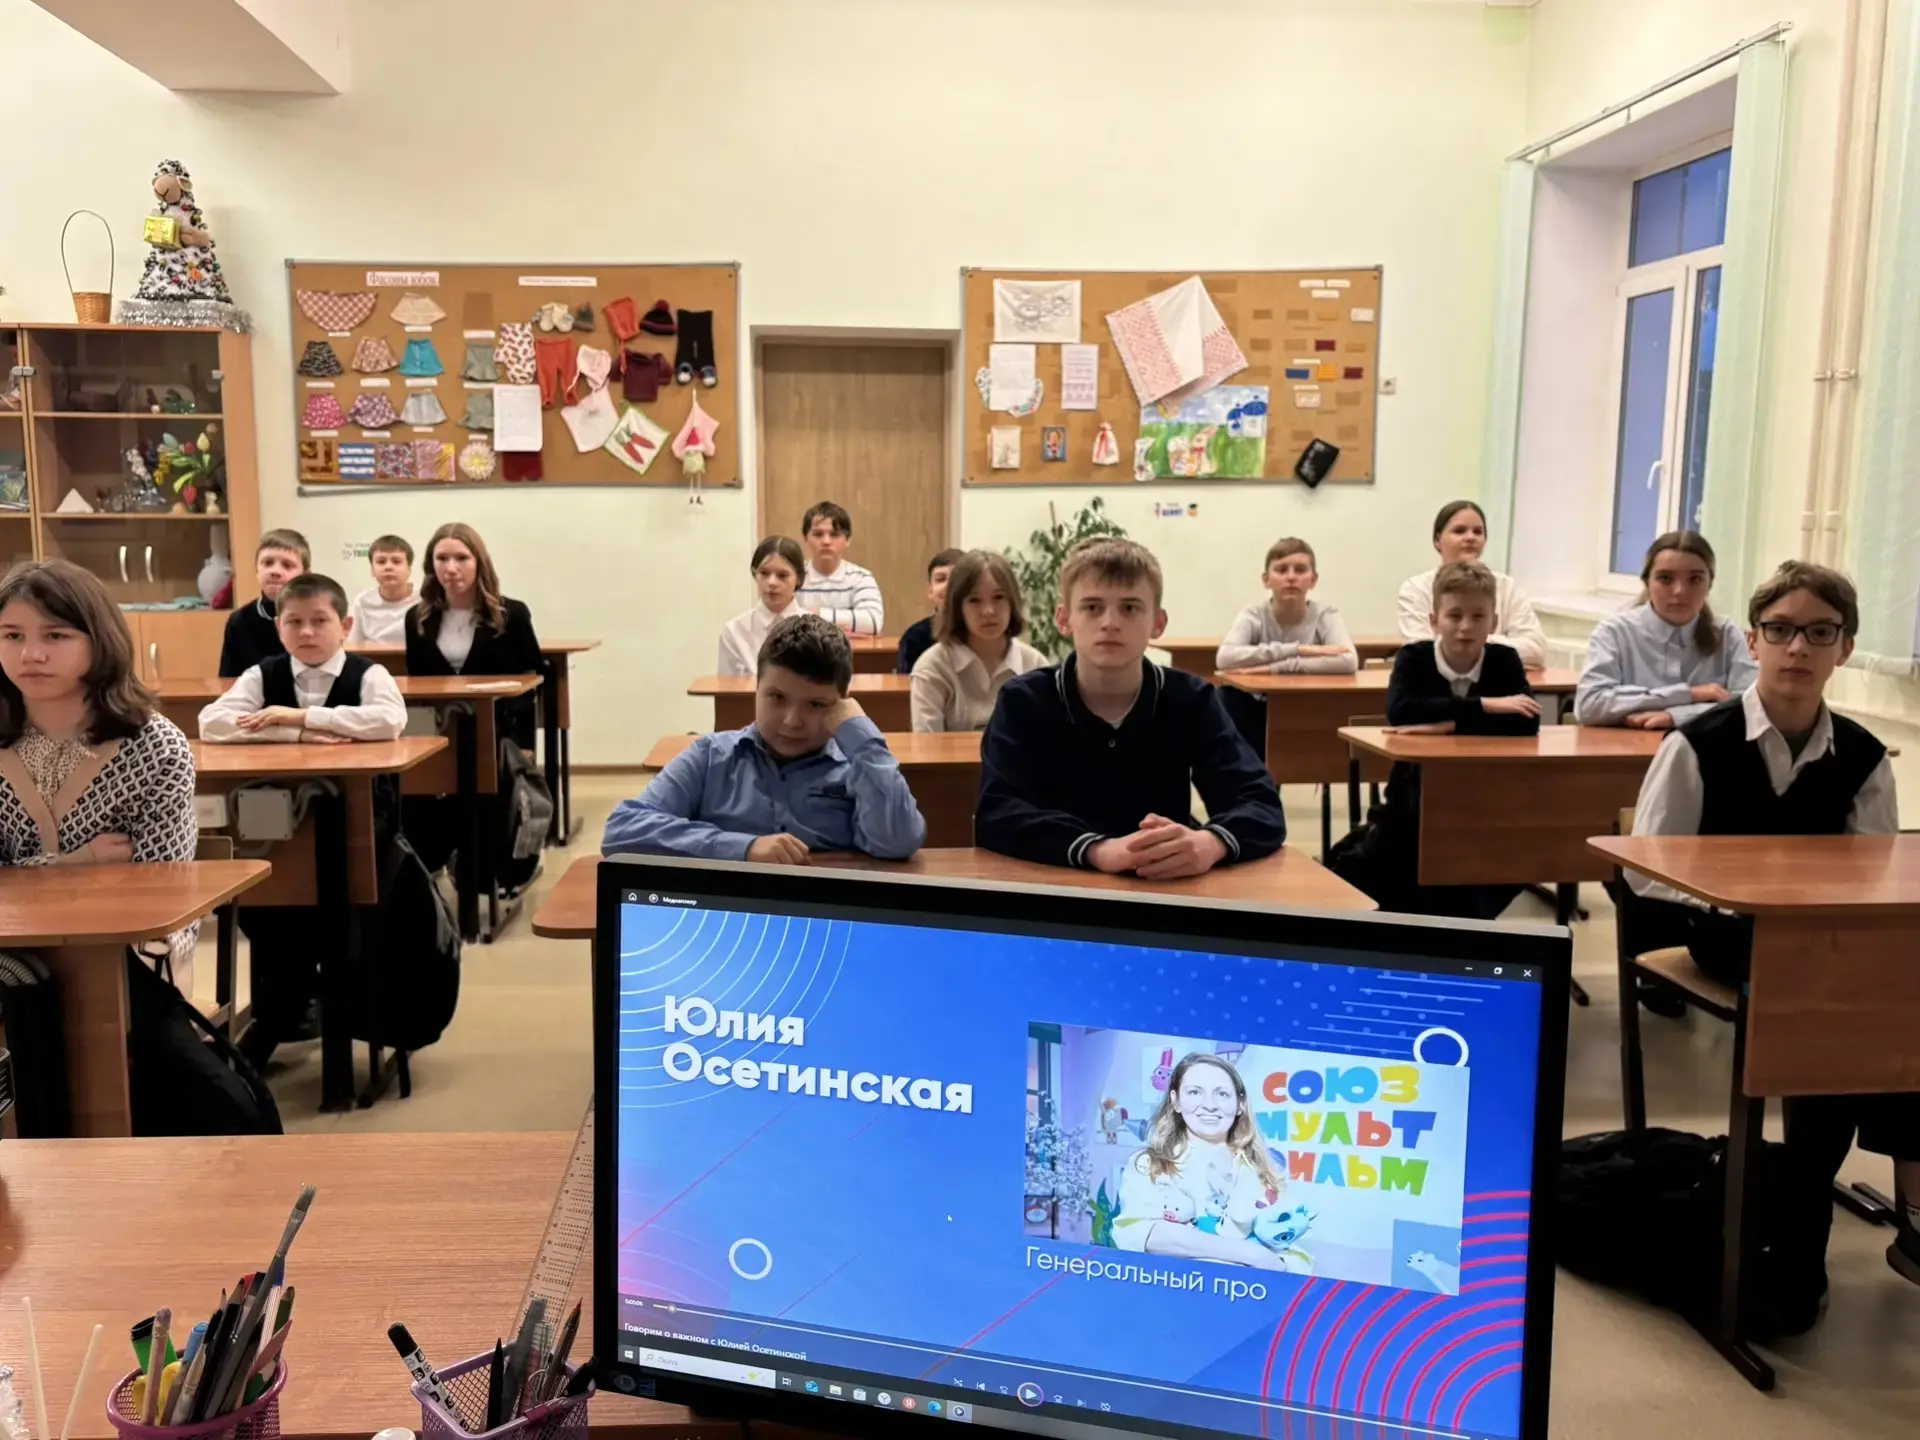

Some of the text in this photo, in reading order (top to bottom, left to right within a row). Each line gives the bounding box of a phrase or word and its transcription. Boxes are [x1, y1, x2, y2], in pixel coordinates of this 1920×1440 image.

[663, 995, 806, 1046] Юлия
[662, 1042, 974, 1114] Осетинская
[1262, 1064, 1421, 1104] СОЮЗ
[1026, 1245, 1267, 1302] Генеральный про
[624, 1322, 663, 1338] Говорим
[672, 1333, 709, 1345] важном
[717, 1339, 750, 1352] Юлией
[751, 1344, 808, 1361] Осетинской
